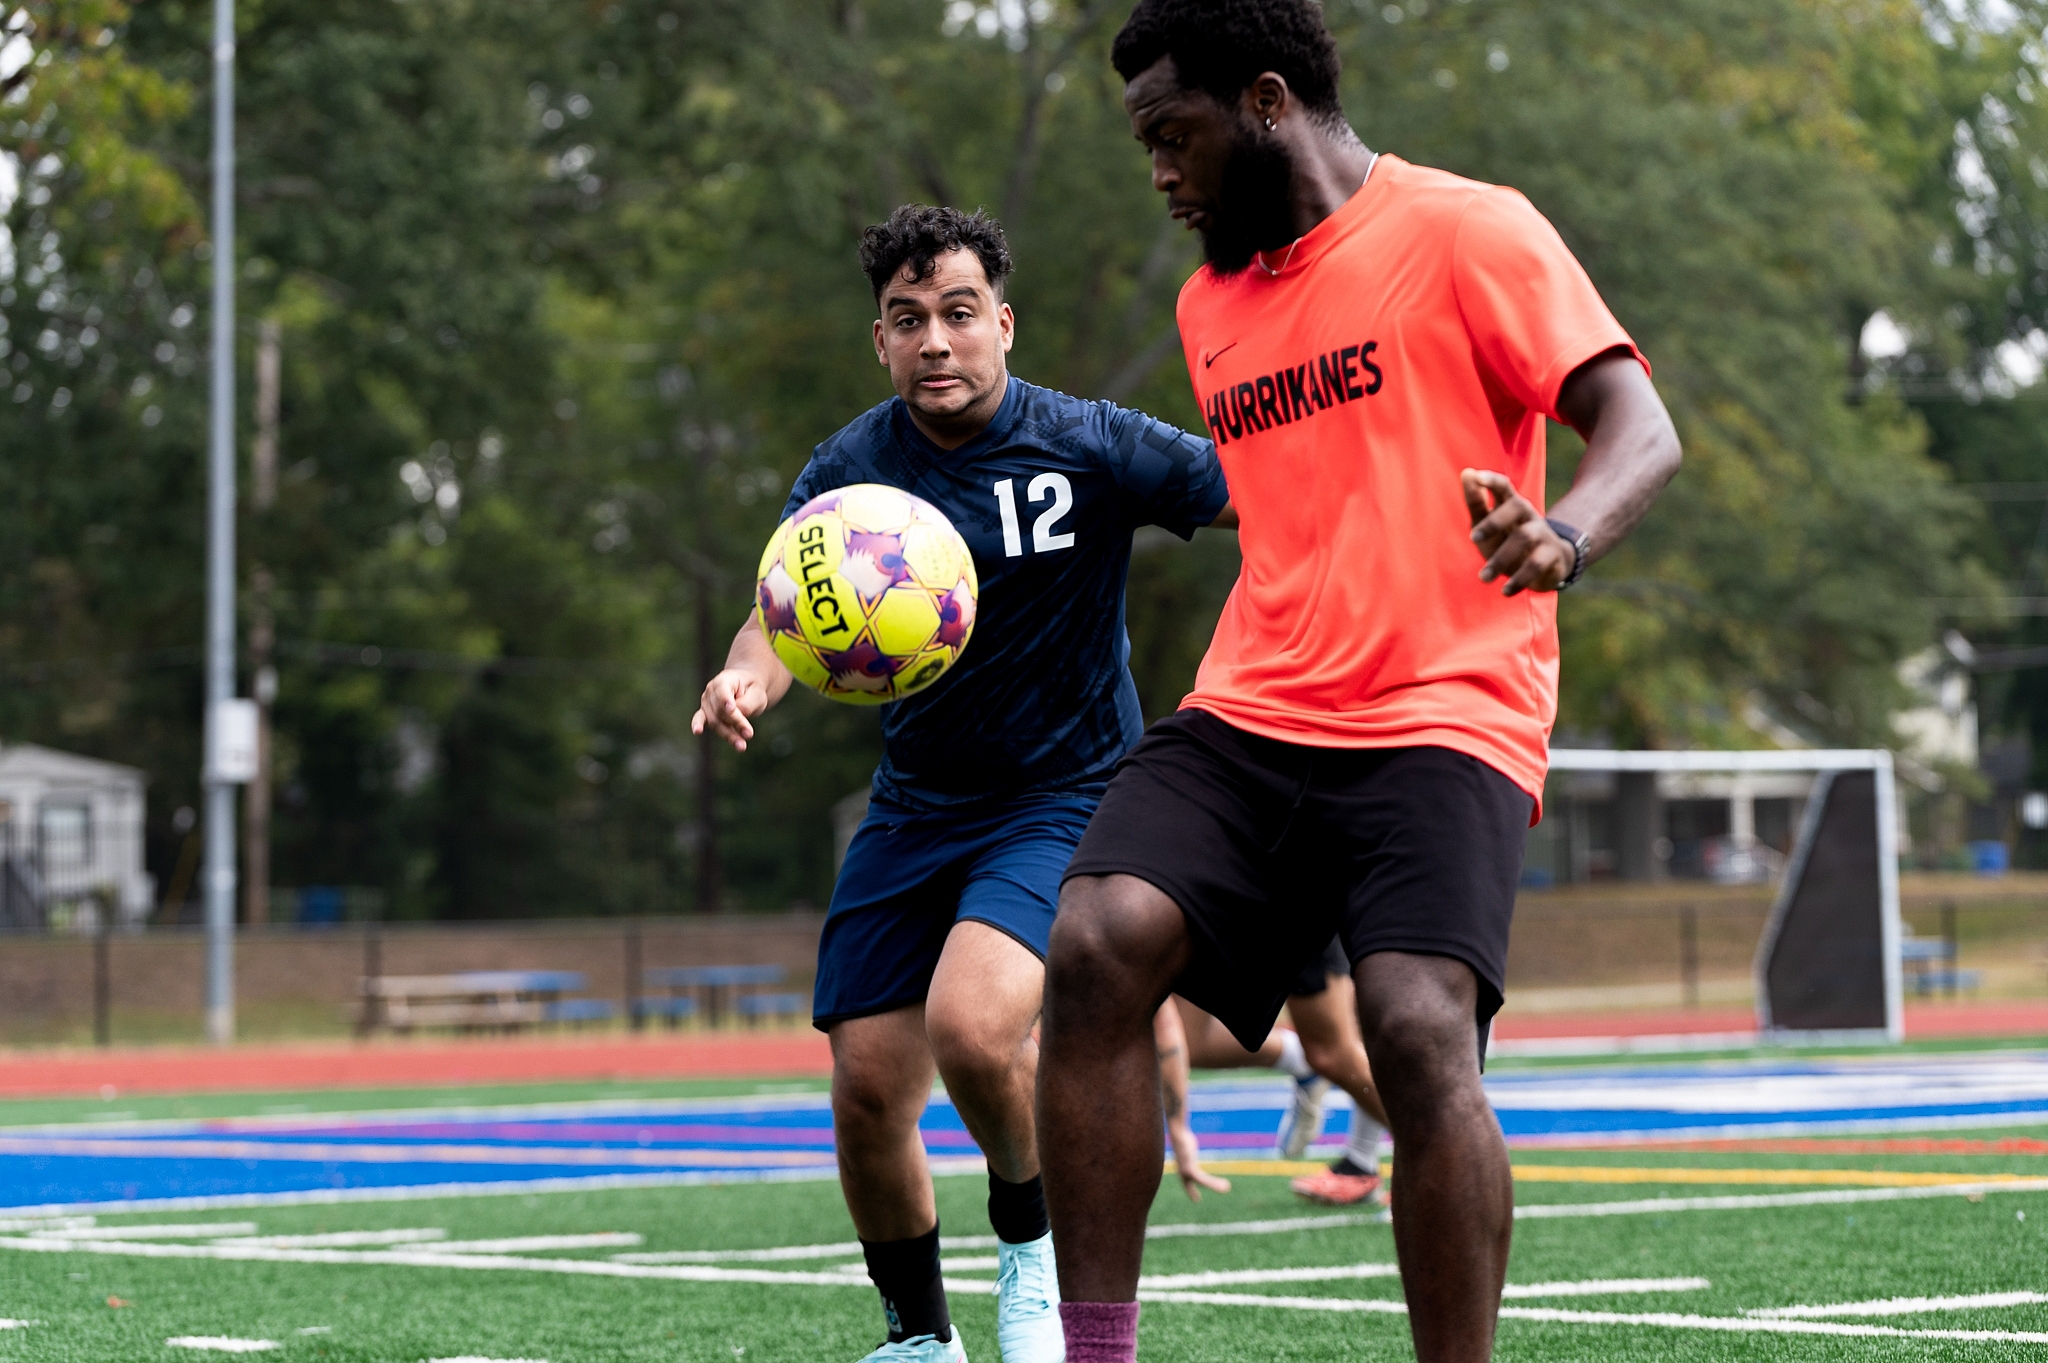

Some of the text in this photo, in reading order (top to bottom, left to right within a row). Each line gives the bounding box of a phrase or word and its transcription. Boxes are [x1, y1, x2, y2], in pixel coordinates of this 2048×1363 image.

[1206, 340, 1384, 448] HURRIKANES
[993, 472, 1076, 558] 12
[799, 525, 850, 637] SELECT
